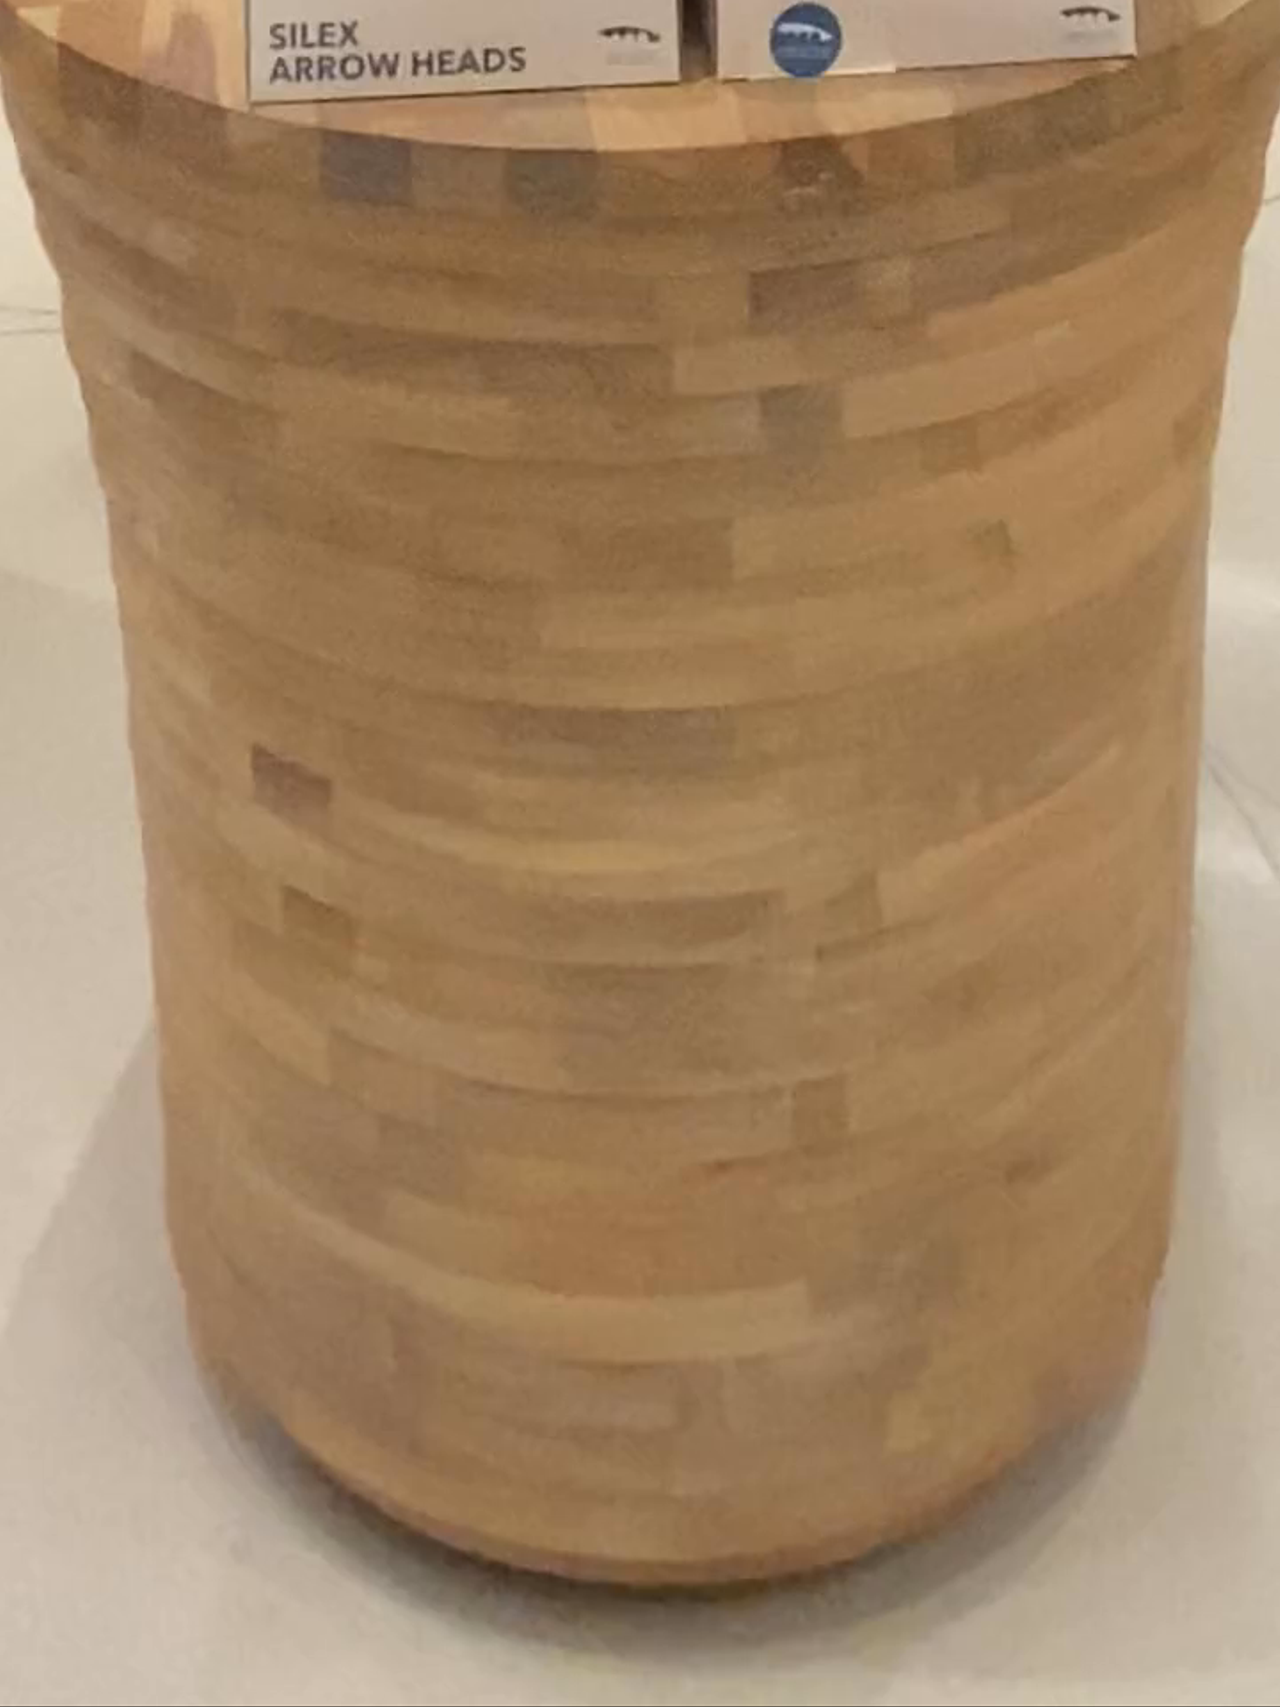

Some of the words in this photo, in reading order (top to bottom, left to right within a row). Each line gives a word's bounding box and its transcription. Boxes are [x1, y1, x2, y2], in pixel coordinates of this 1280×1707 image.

[269, 19, 359, 50] SILEX
[269, 51, 401, 85] ARROW
[411, 46, 527, 77] HEADS
